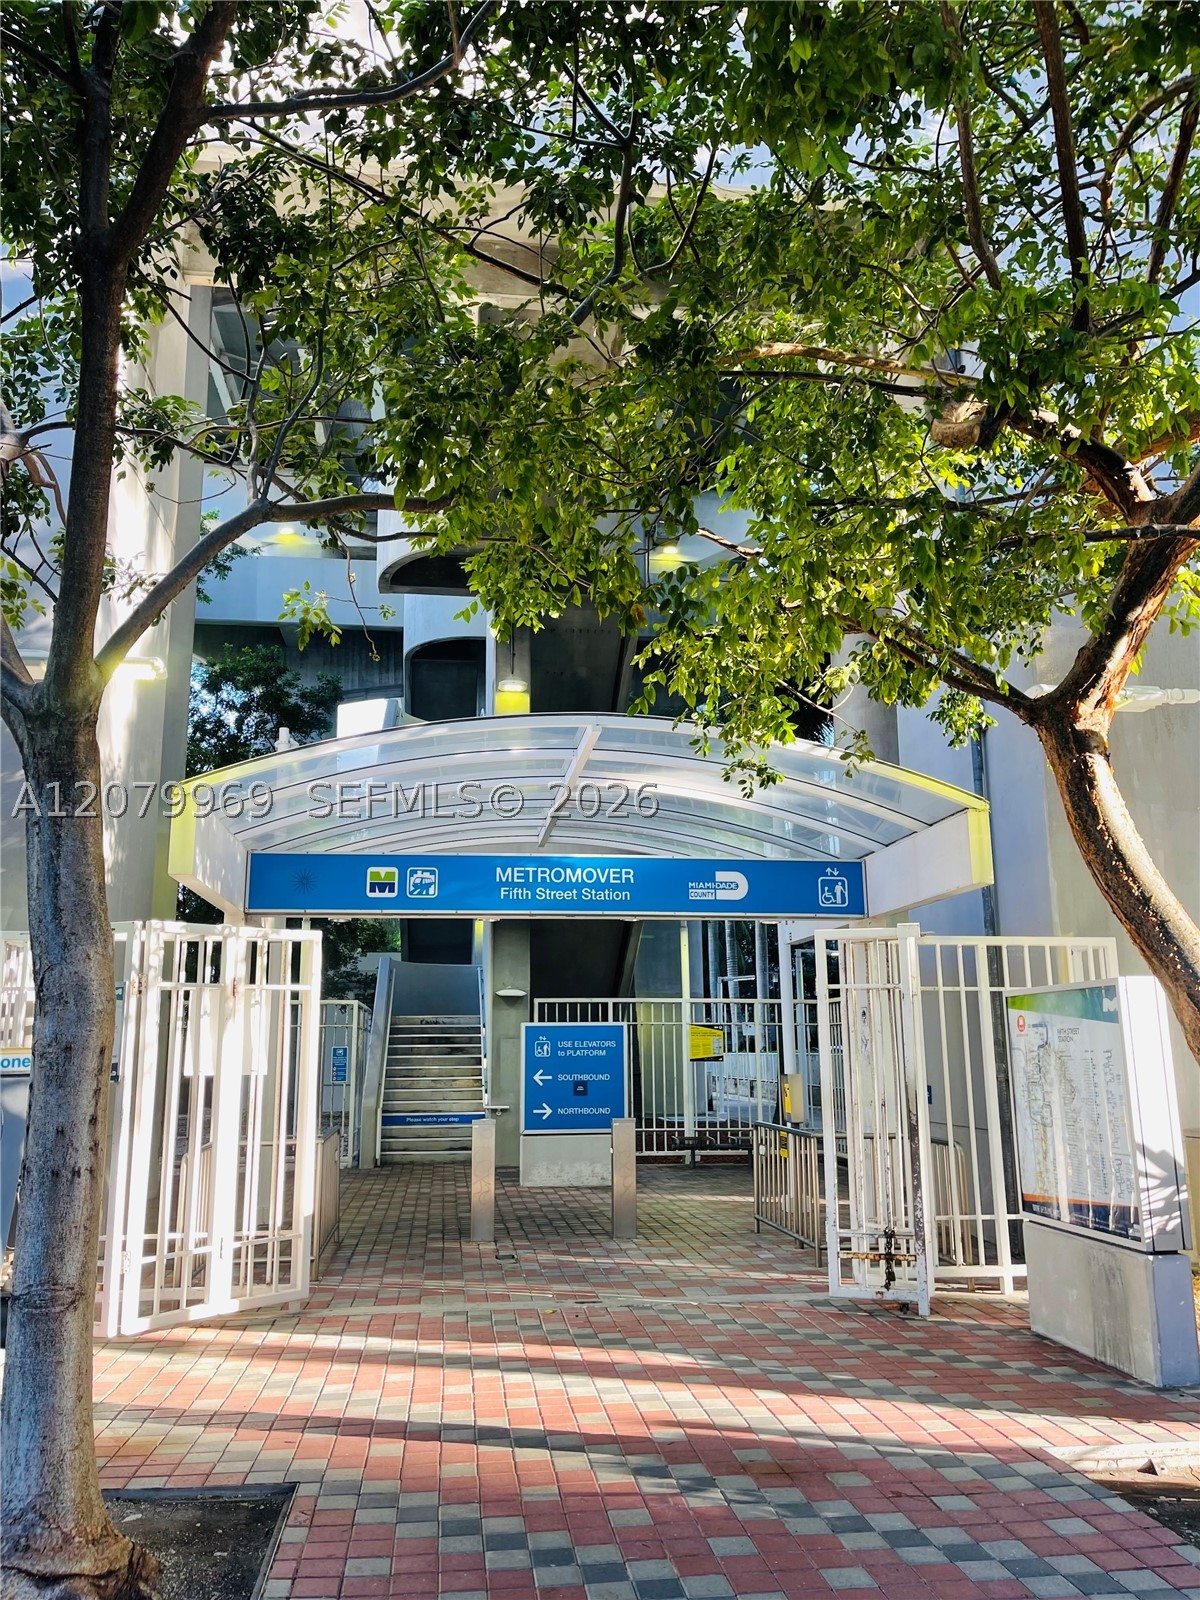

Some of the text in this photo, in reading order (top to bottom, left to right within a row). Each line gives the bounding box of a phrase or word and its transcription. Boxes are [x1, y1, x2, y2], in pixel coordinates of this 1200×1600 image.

[495, 867, 635, 883] METROMOVER
[688, 881, 738, 889] MIAMI-DADE
[500, 887, 631, 901] Fifth Street Station
[689, 890, 714, 898] COUNTY
[566, 1049, 606, 1057] PLATFORM
[557, 1107, 611, 1115] NORTHBOUND
